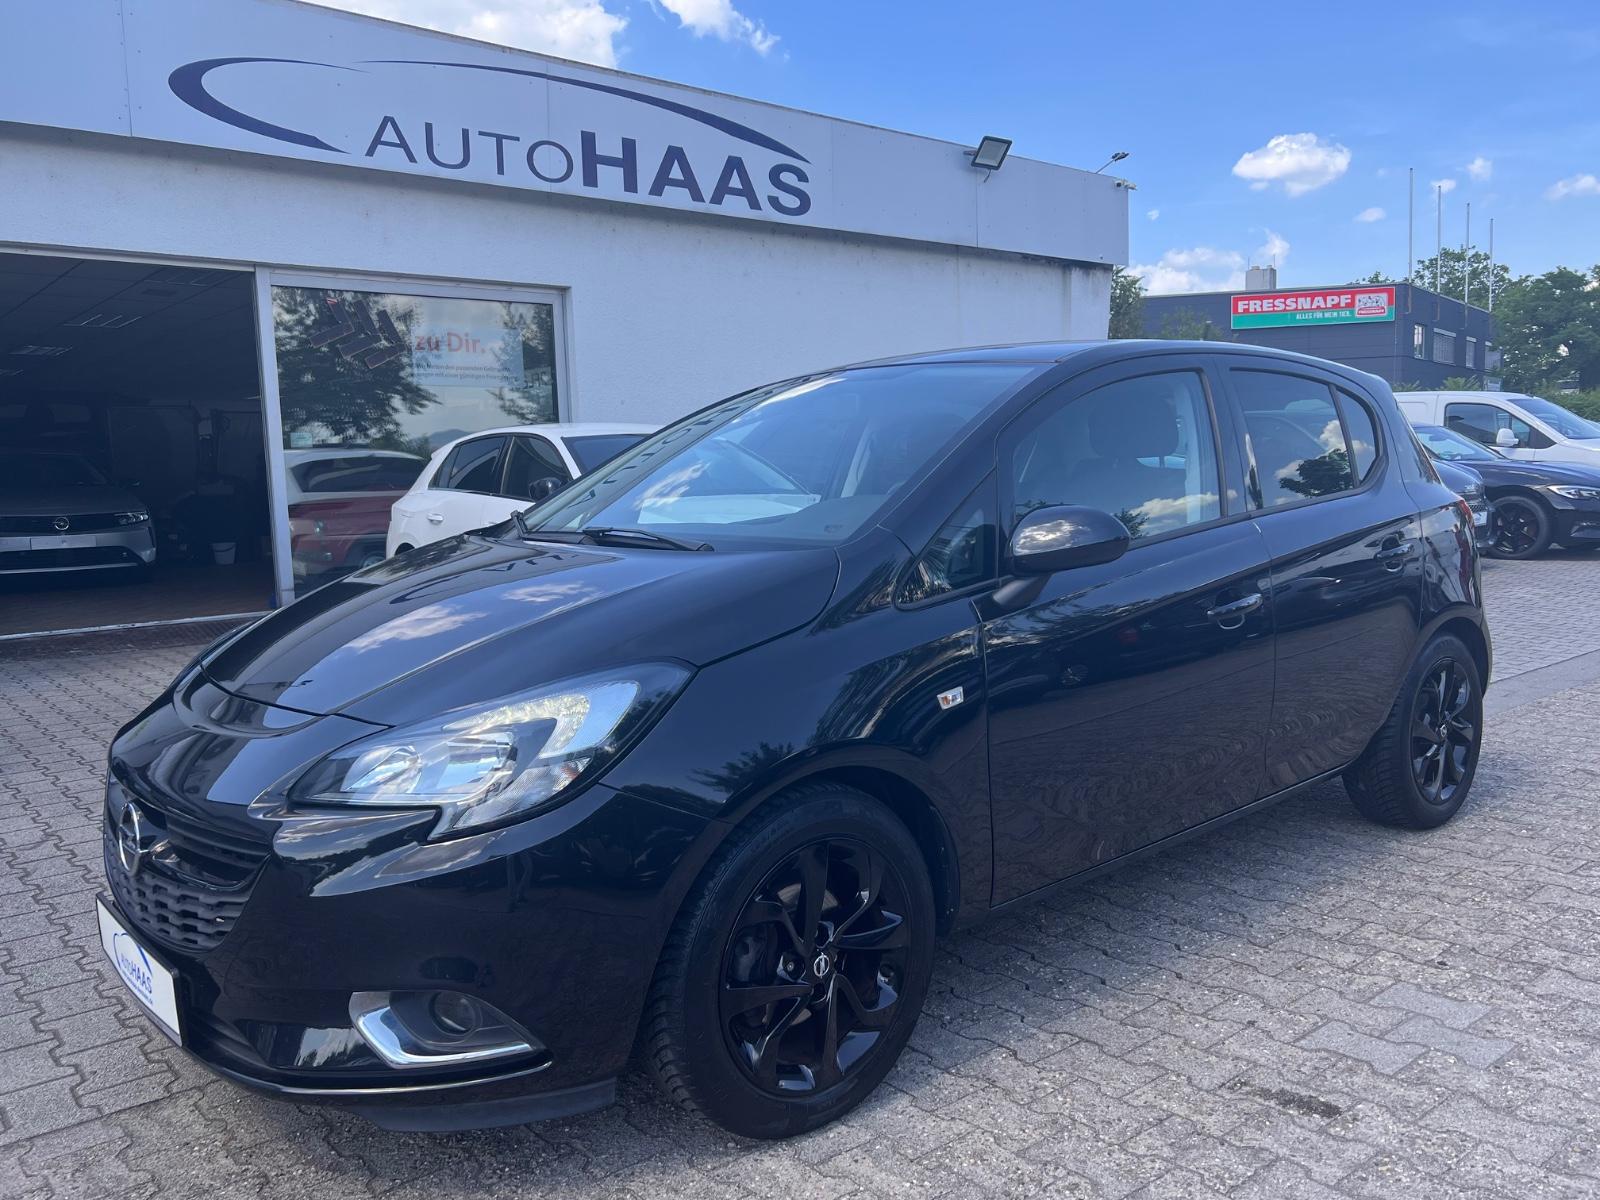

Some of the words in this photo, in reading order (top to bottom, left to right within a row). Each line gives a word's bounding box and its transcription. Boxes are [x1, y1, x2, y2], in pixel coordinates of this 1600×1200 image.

[1237, 295, 1352, 313] FRESSNAPF
[415, 336, 440, 351] zu
[447, 331, 485, 353] Dir.
